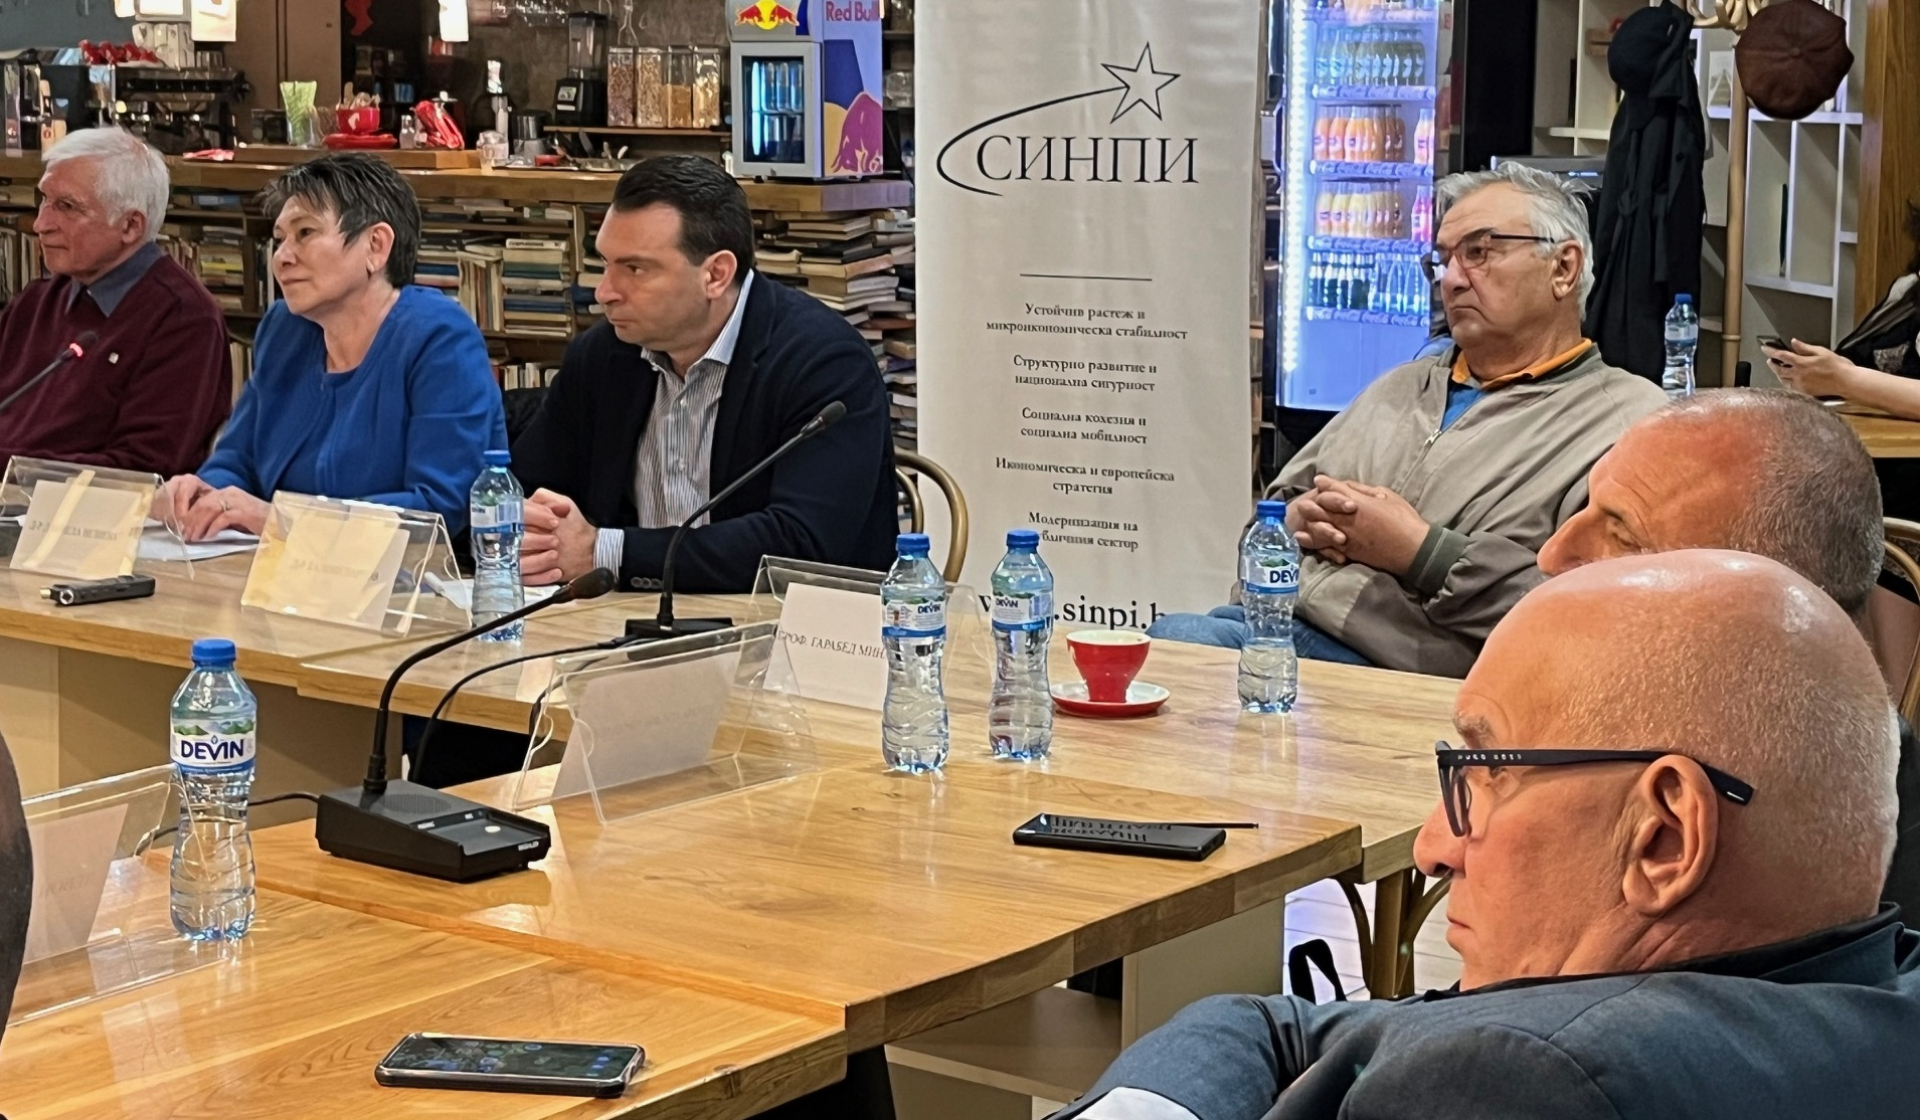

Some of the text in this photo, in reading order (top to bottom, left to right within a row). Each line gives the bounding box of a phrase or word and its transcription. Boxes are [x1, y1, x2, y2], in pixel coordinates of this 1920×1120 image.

[825, 1, 879, 22] Red Bull
[976, 135, 1199, 184] СИНПИ
[1025, 303, 1146, 321] Устойчив растеж и
[986, 322, 1188, 339] микроикономическа стабилност
[1013, 354, 1157, 373] Структурно развитие и
[1015, 375, 1155, 393] национална сигурност
[1022, 407, 1147, 426] Социална кохезия и
[1021, 428, 1147, 444] социална мобилност
[996, 457, 1175, 482] Икономическа и европейска
[1053, 482, 1113, 495] стратегия
[1028, 511, 1139, 531] Модернизация на
[1041, 530, 1139, 552] бличния сектор
[1270, 569, 1300, 583] DEVI
[917, 603, 941, 614] DEVIN
[811, 637, 858, 656] ГАРАБЕД
[181, 739, 244, 761] DEVIN
